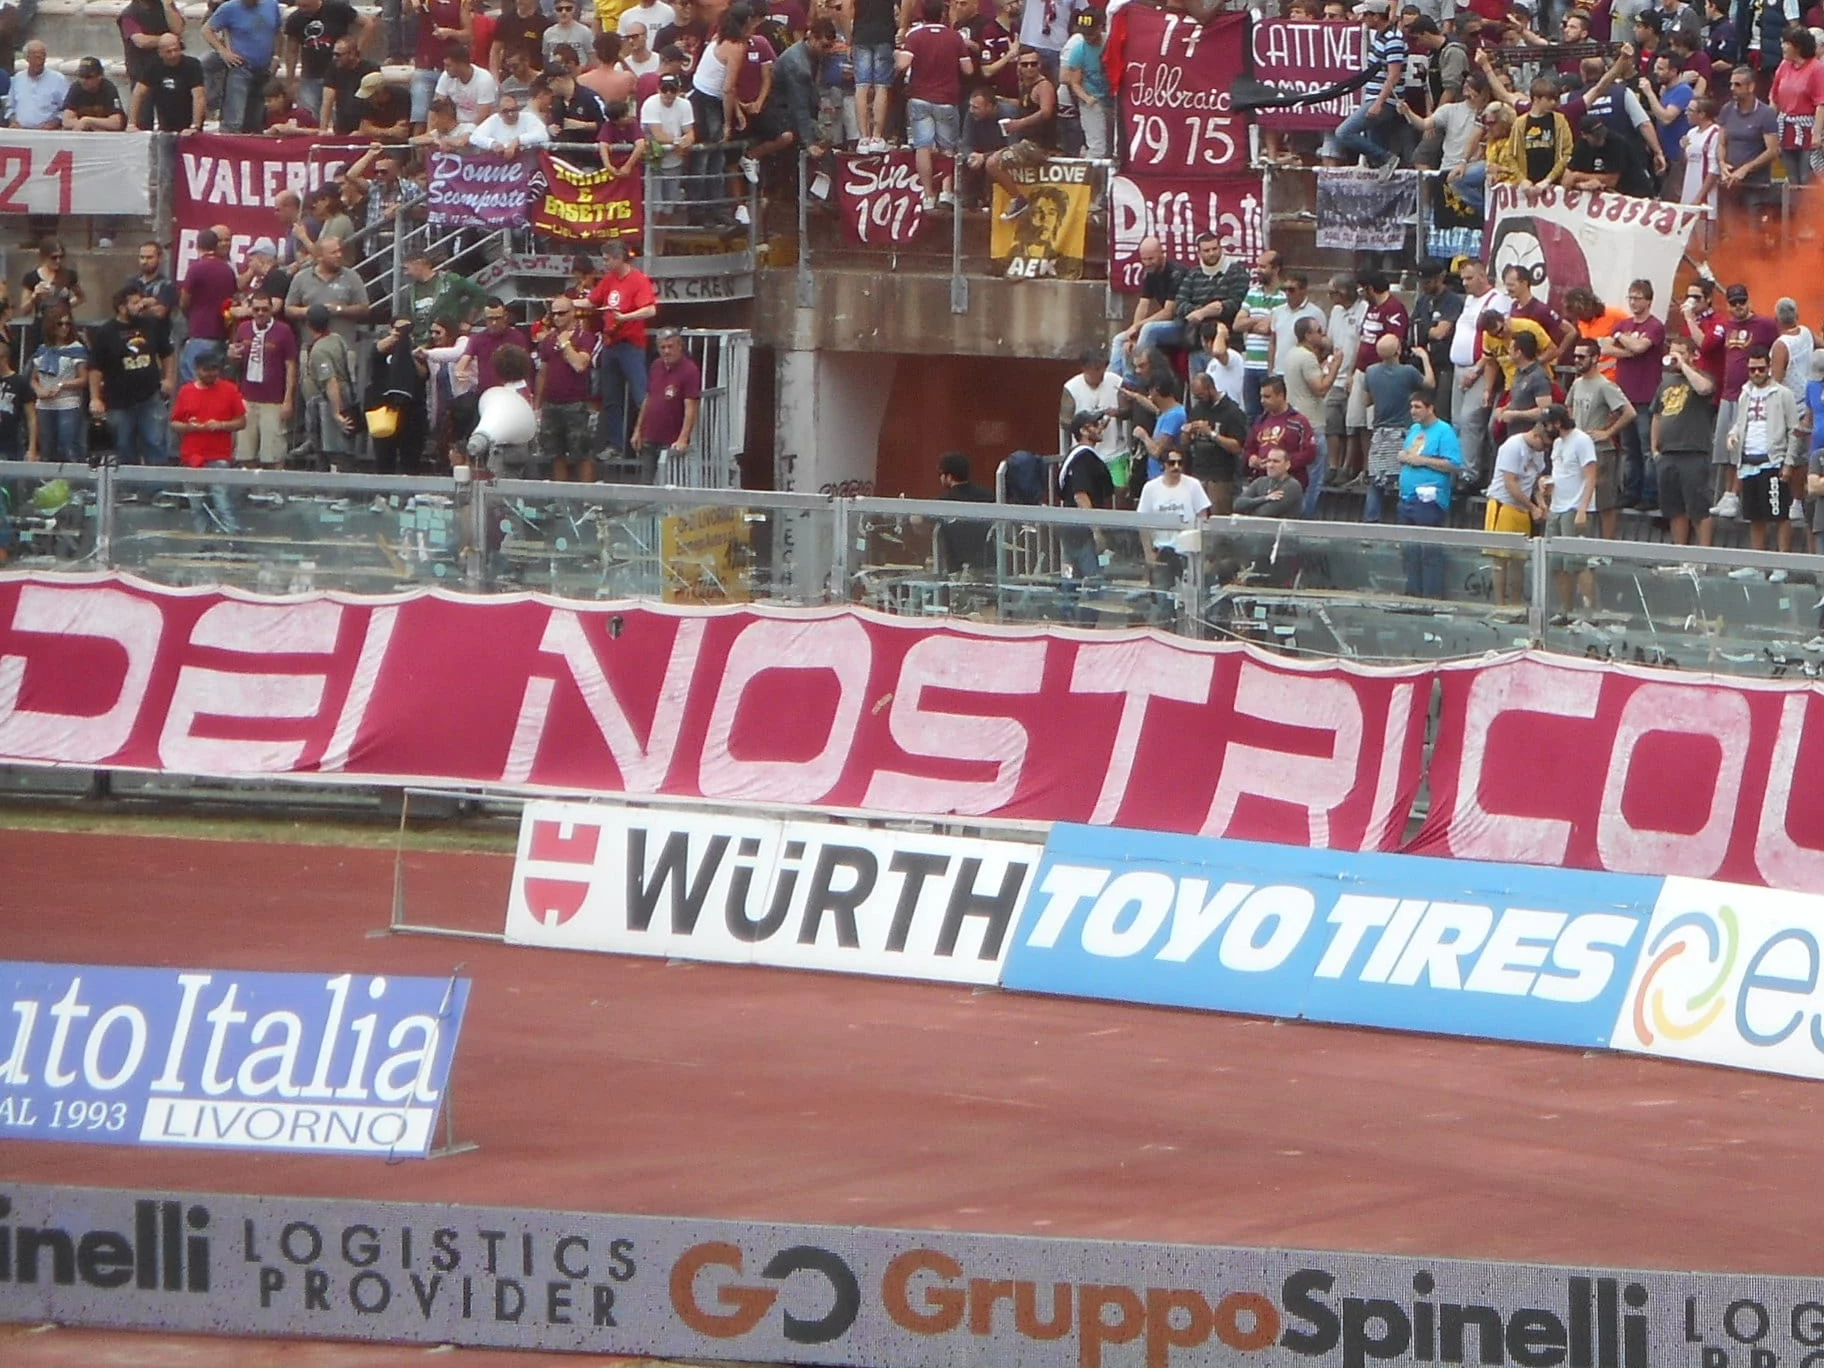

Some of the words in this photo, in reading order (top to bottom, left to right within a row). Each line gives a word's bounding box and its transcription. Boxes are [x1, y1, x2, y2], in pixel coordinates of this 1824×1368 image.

[431, 151, 524, 183] Donne
[1039, 165, 1086, 183] LOVE
[427, 180, 526, 215] Scomposte
[1006, 256, 1057, 278] AEK
[500, 608, 1414, 852] NOSTRI
[1027, 864, 1315, 973] TOYO
[1315, 893, 1647, 1005] TIRES
[48, 1098, 128, 1131] 1993
[161, 1103, 408, 1147] LIVORNO
[243, 1217, 638, 1284] LOGISTICS
[258, 1266, 618, 1329] PROVIDER
